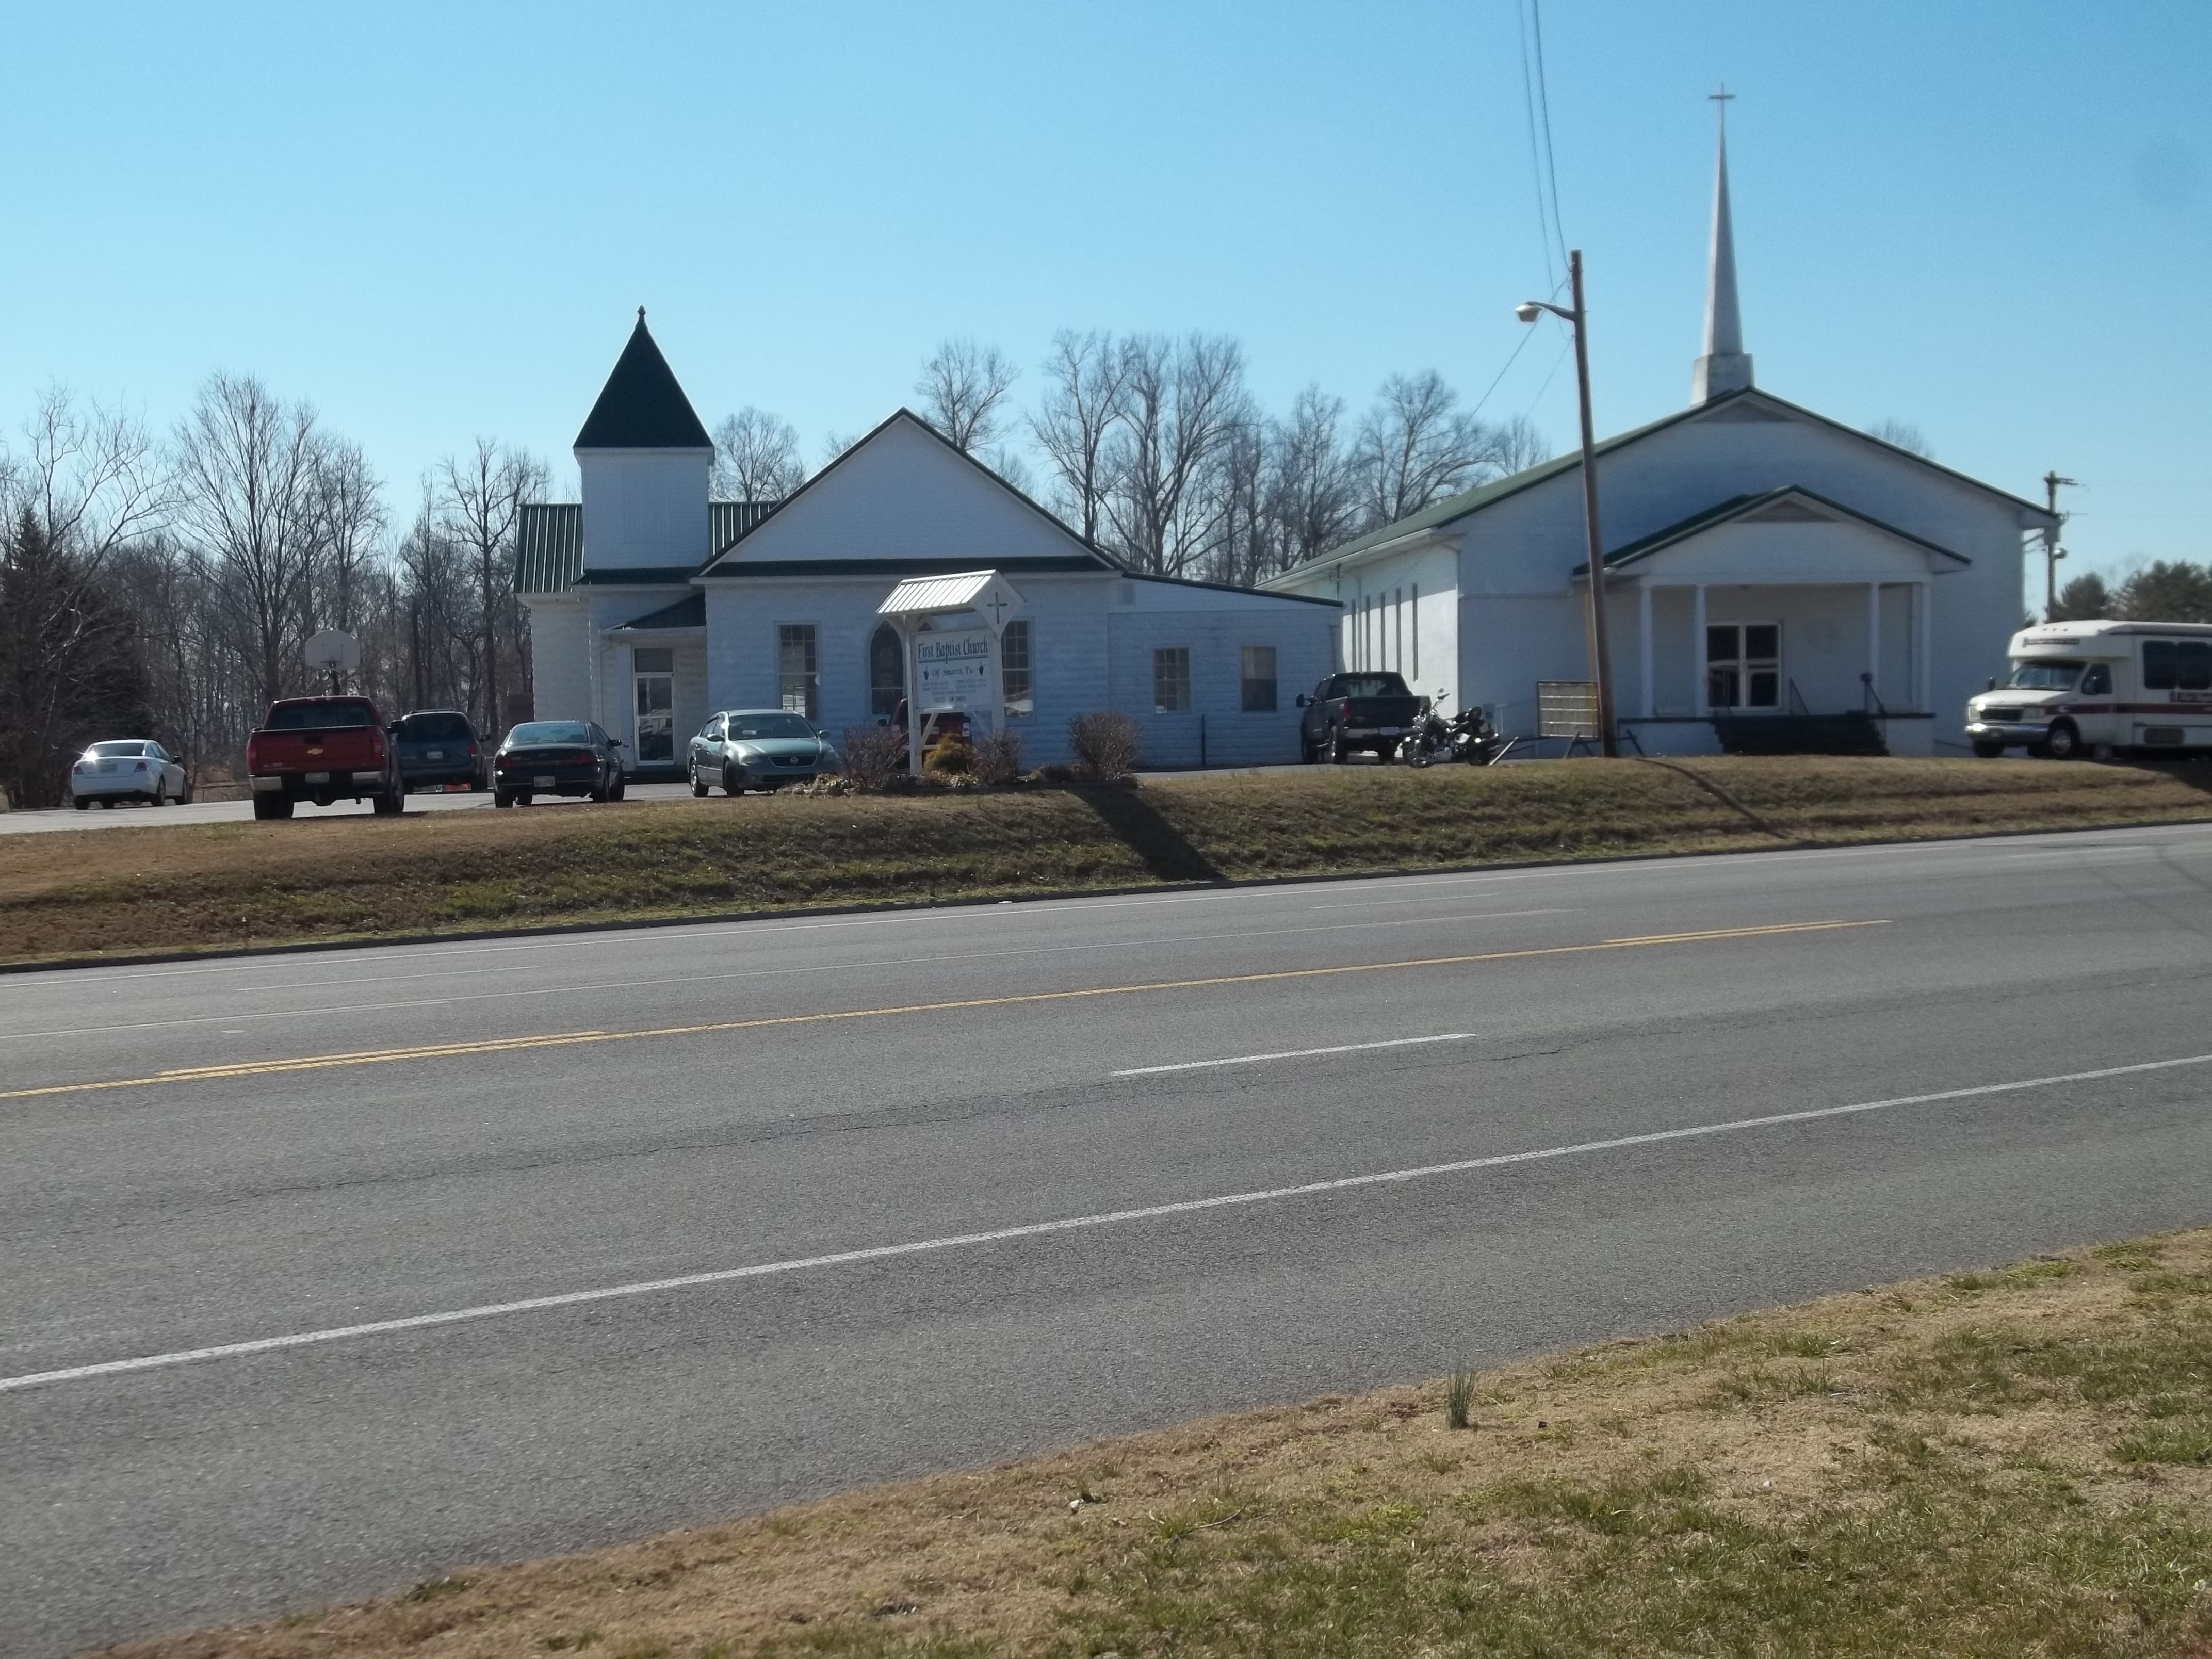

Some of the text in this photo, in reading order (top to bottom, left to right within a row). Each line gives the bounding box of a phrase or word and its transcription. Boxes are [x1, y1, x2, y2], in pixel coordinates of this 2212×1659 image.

[918, 635, 988, 664] First Baptist Church
[932, 669, 939, 677] Of
